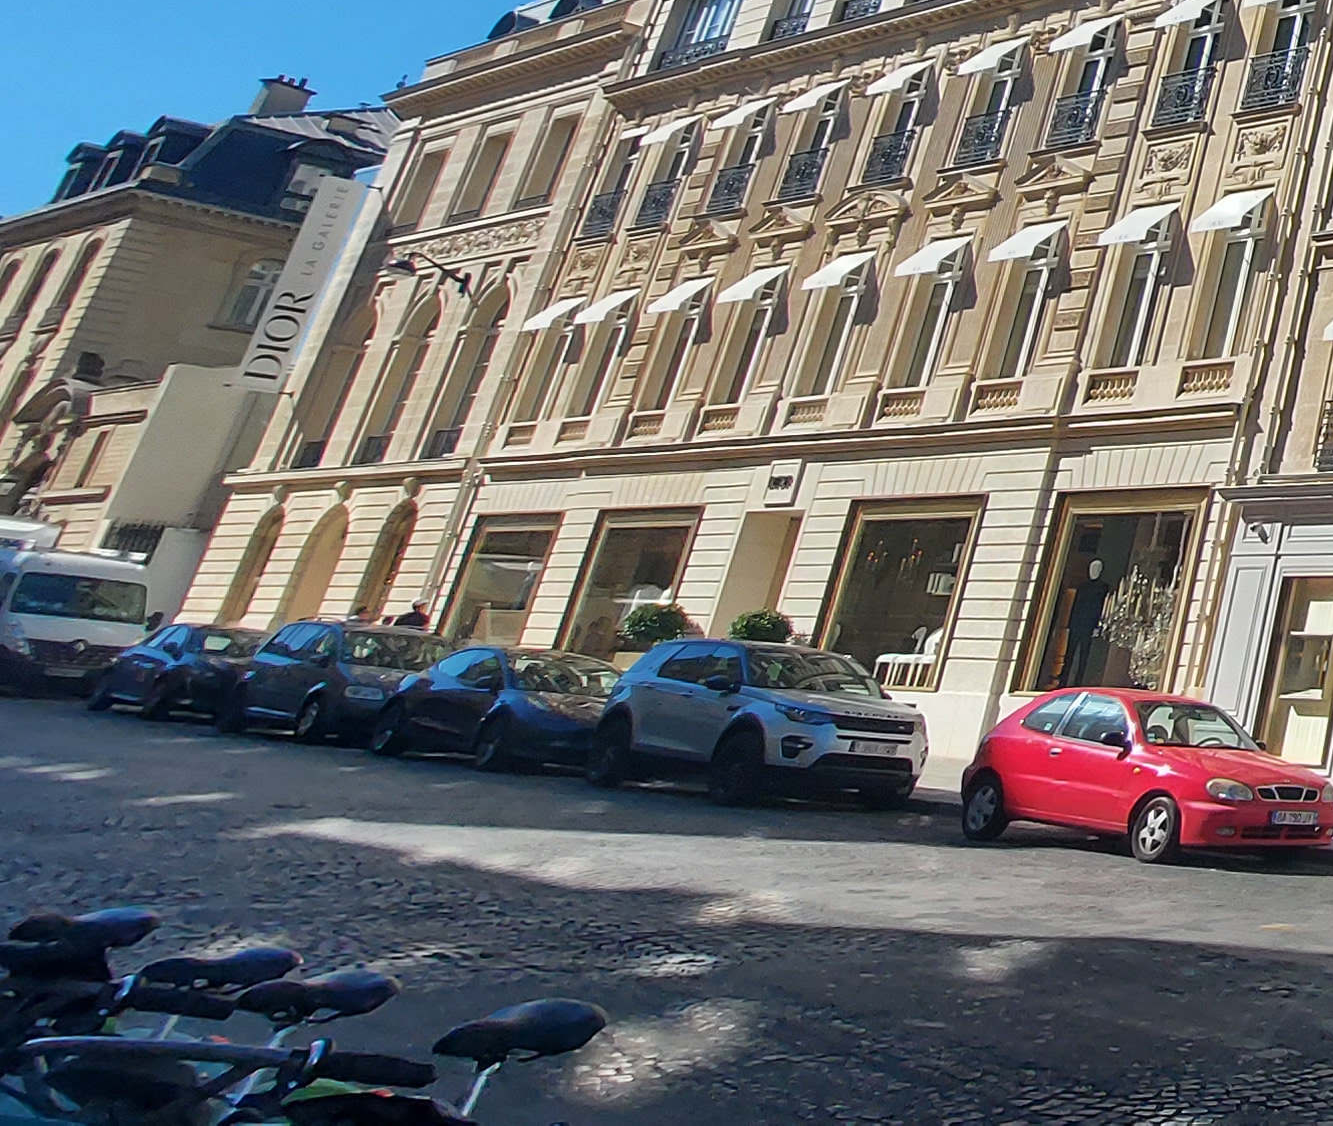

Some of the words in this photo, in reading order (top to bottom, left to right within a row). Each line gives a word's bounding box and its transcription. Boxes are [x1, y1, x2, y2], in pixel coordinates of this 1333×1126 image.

[243, 291, 316, 381] DIOR
[301, 260, 317, 276] LA
[312, 185, 349, 252] GALERIE
